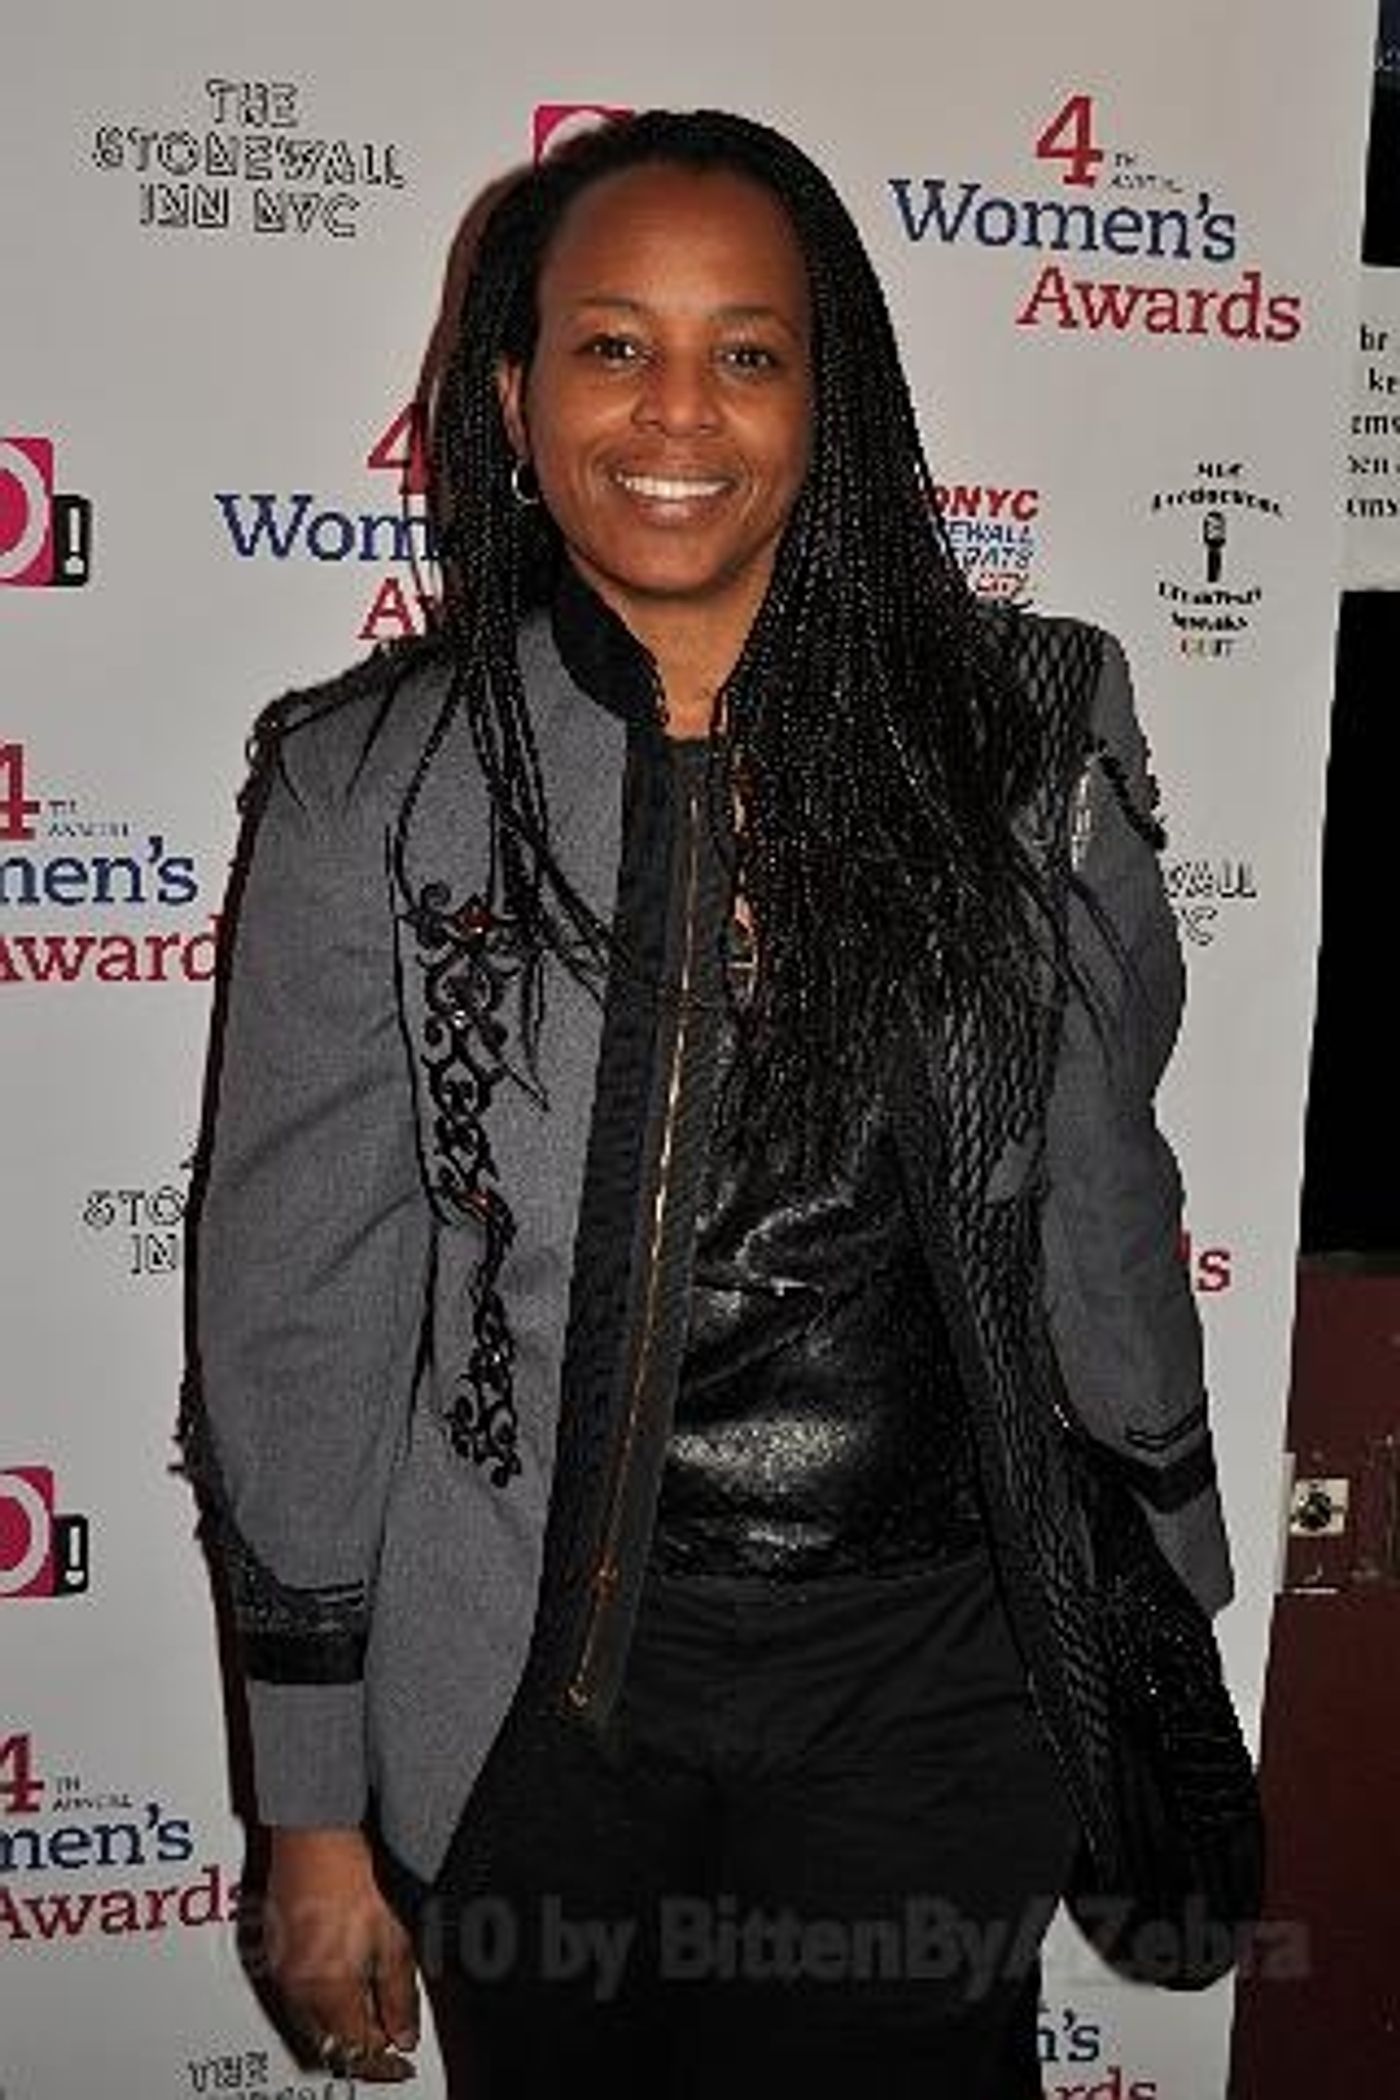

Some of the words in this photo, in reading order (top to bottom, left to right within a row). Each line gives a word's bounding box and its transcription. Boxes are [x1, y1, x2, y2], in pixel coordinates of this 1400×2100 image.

[205, 78, 298, 128] THE
[91, 126, 404, 190] STONEWALL
[1036, 95, 1104, 188] 4
[139, 183, 229, 229] INN
[254, 188, 360, 238] NYC
[888, 179, 1237, 262] Women's
[1016, 266, 1302, 343] Awards
